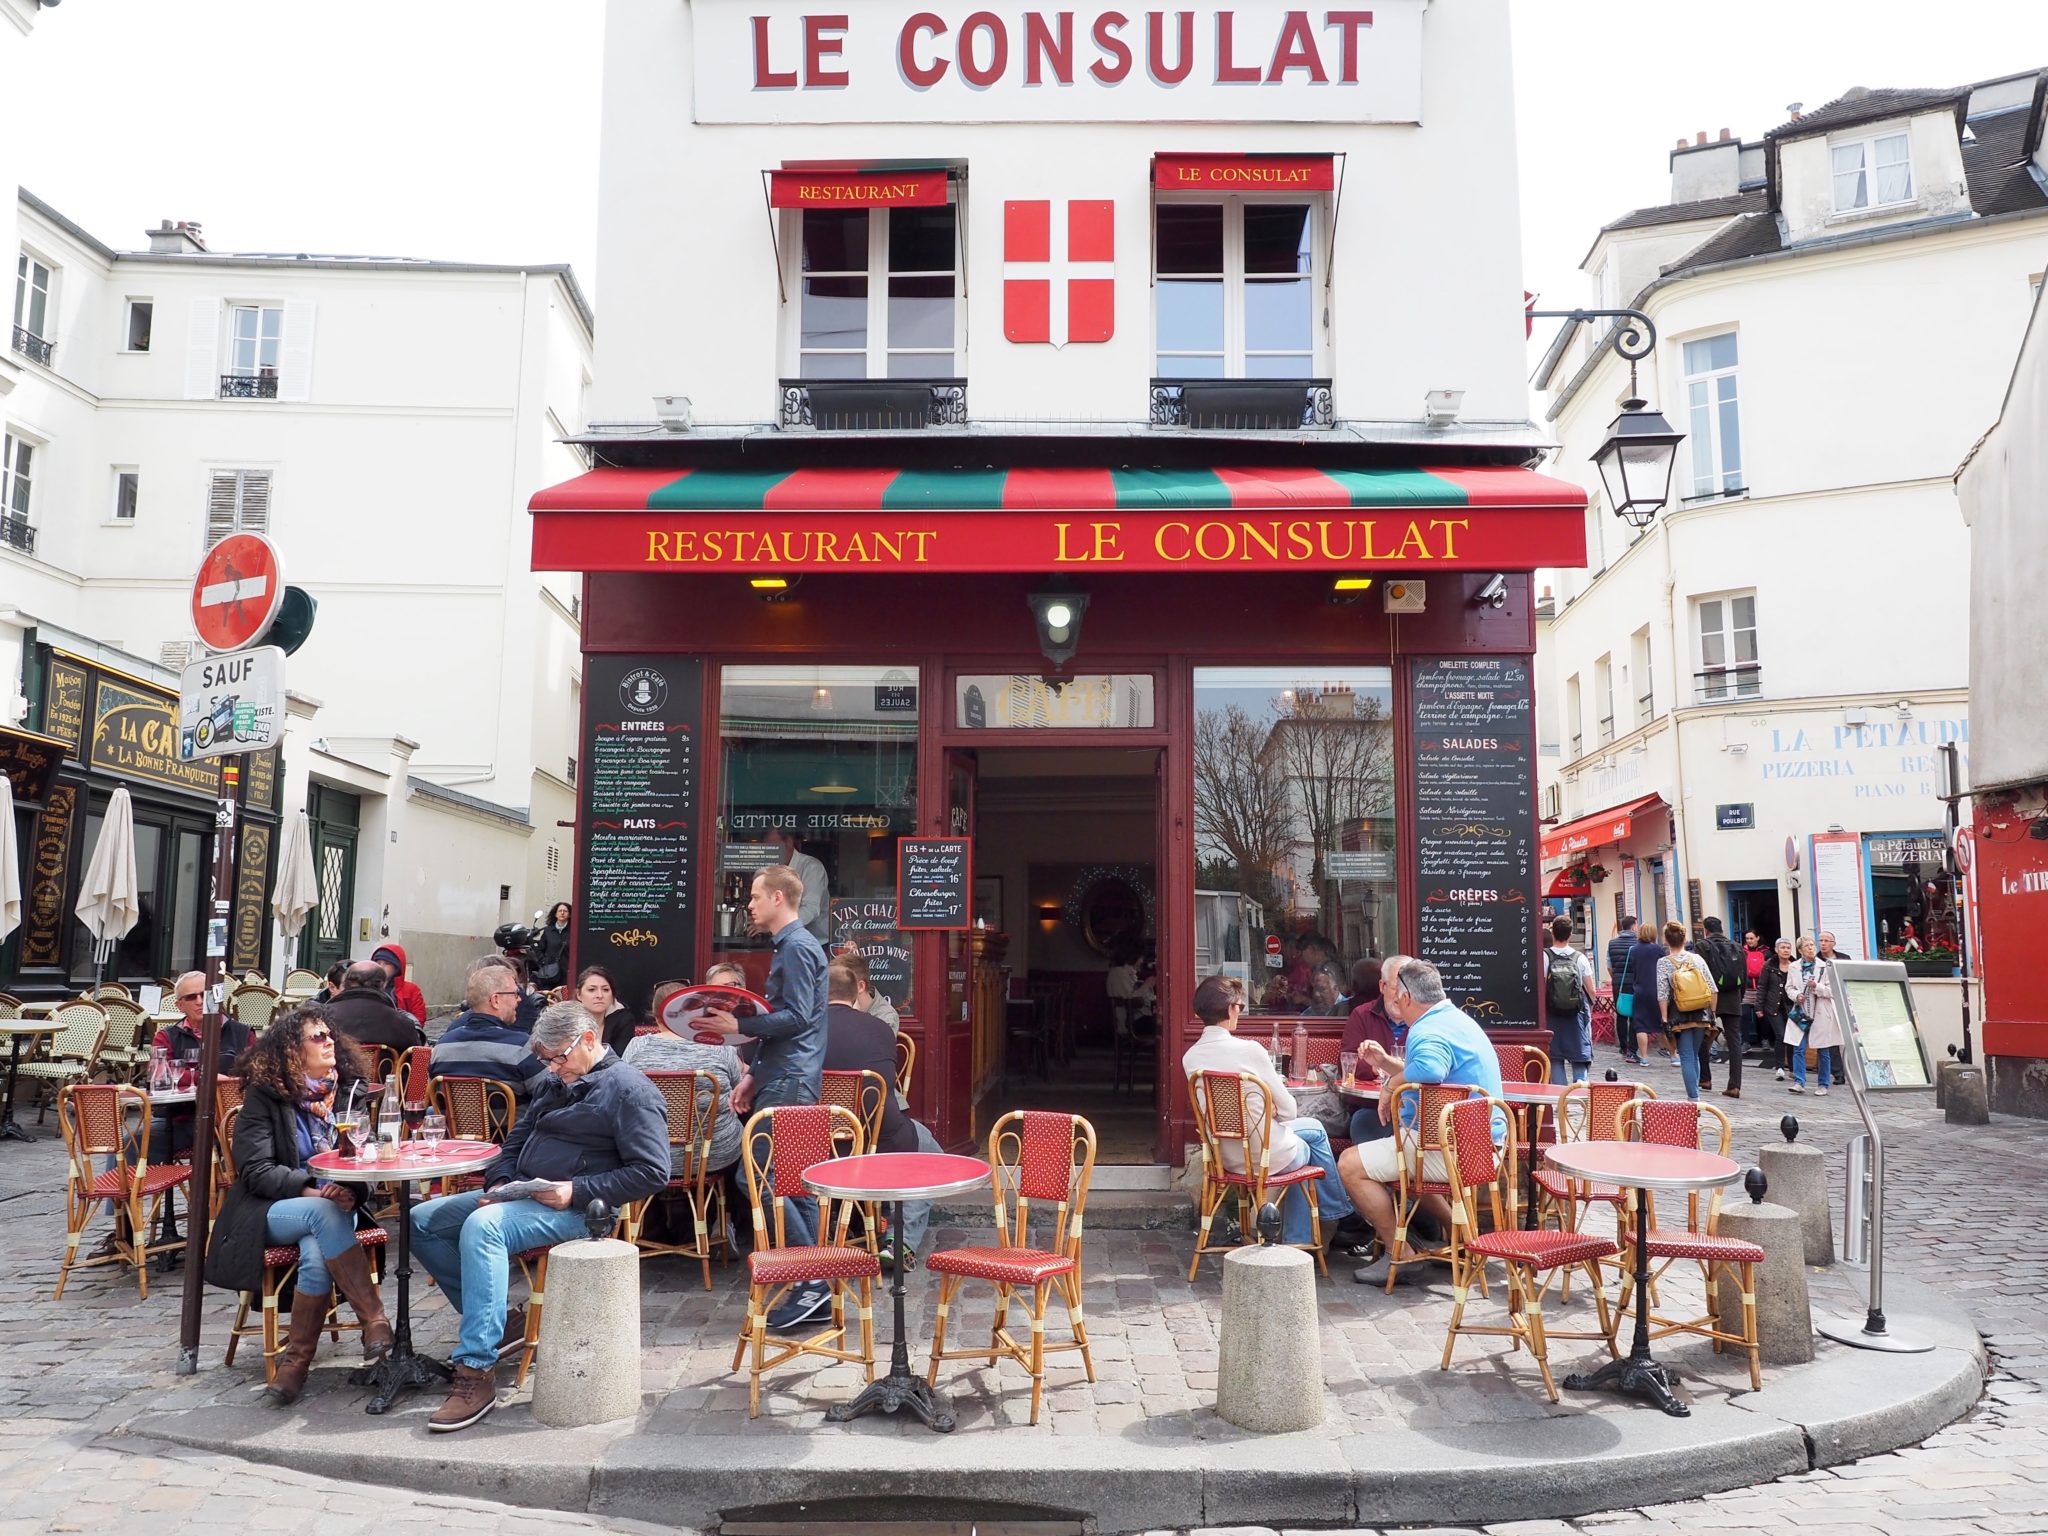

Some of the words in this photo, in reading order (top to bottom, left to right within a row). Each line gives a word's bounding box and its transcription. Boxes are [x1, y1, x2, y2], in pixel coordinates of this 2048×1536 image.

[750, 15, 849, 92] LE
[895, 11, 1373, 92] CONSULAT
[1178, 167, 1201, 181] LE
[1210, 168, 1311, 182] CONSULAT
[800, 184, 919, 200] RESTAURANT
[644, 531, 937, 562] RESTAURANT
[1053, 523, 1125, 561] LE
[1154, 519, 1469, 560] CONSULAT
[1439, 660, 1469, 669] OMELETTE
[202, 658, 254, 688] SAUF
[621, 670, 643, 689] Bistrot
[1444, 691, 1475, 700] L'ASSIETTE
[1477, 691, 1495, 700] MIXTE
[1448, 710, 1459, 719] de
[120, 717, 137, 743] LA
[621, 720, 665, 731] ENTRÉES
[1442, 738, 1498, 749] SALADES
[1771, 729, 1813, 753] LA
[118, 746, 132, 763] LA
[135, 750, 164, 772] BONNE
[165, 758, 219, 786] FRANQUETTE
[1762, 760, 1855, 779] PIZZERIA
[1901, 755, 1936, 773] RES
[1855, 784, 1905, 798] PIANO
[623, 819, 656, 829] PLATS
[1722, 817, 1748, 825] POULBOT
[905, 845, 918, 853] LES
[940, 845, 962, 853] CARTE
[1869, 841, 1884, 851] La
[930, 856, 939, 864] de
[1520, 867, 1527, 875] 9
[2001, 876, 2018, 895] Le
[1449, 887, 1498, 901] CRÊPES
[832, 904, 859, 922] VIN
[863, 903, 897, 920] CHAU
[840, 919, 849, 930] à
[851, 919, 862, 930] la
[886, 945, 910, 962] WINE
[868, 957, 890, 970] With
[1522, 973, 1528, 981] 6
